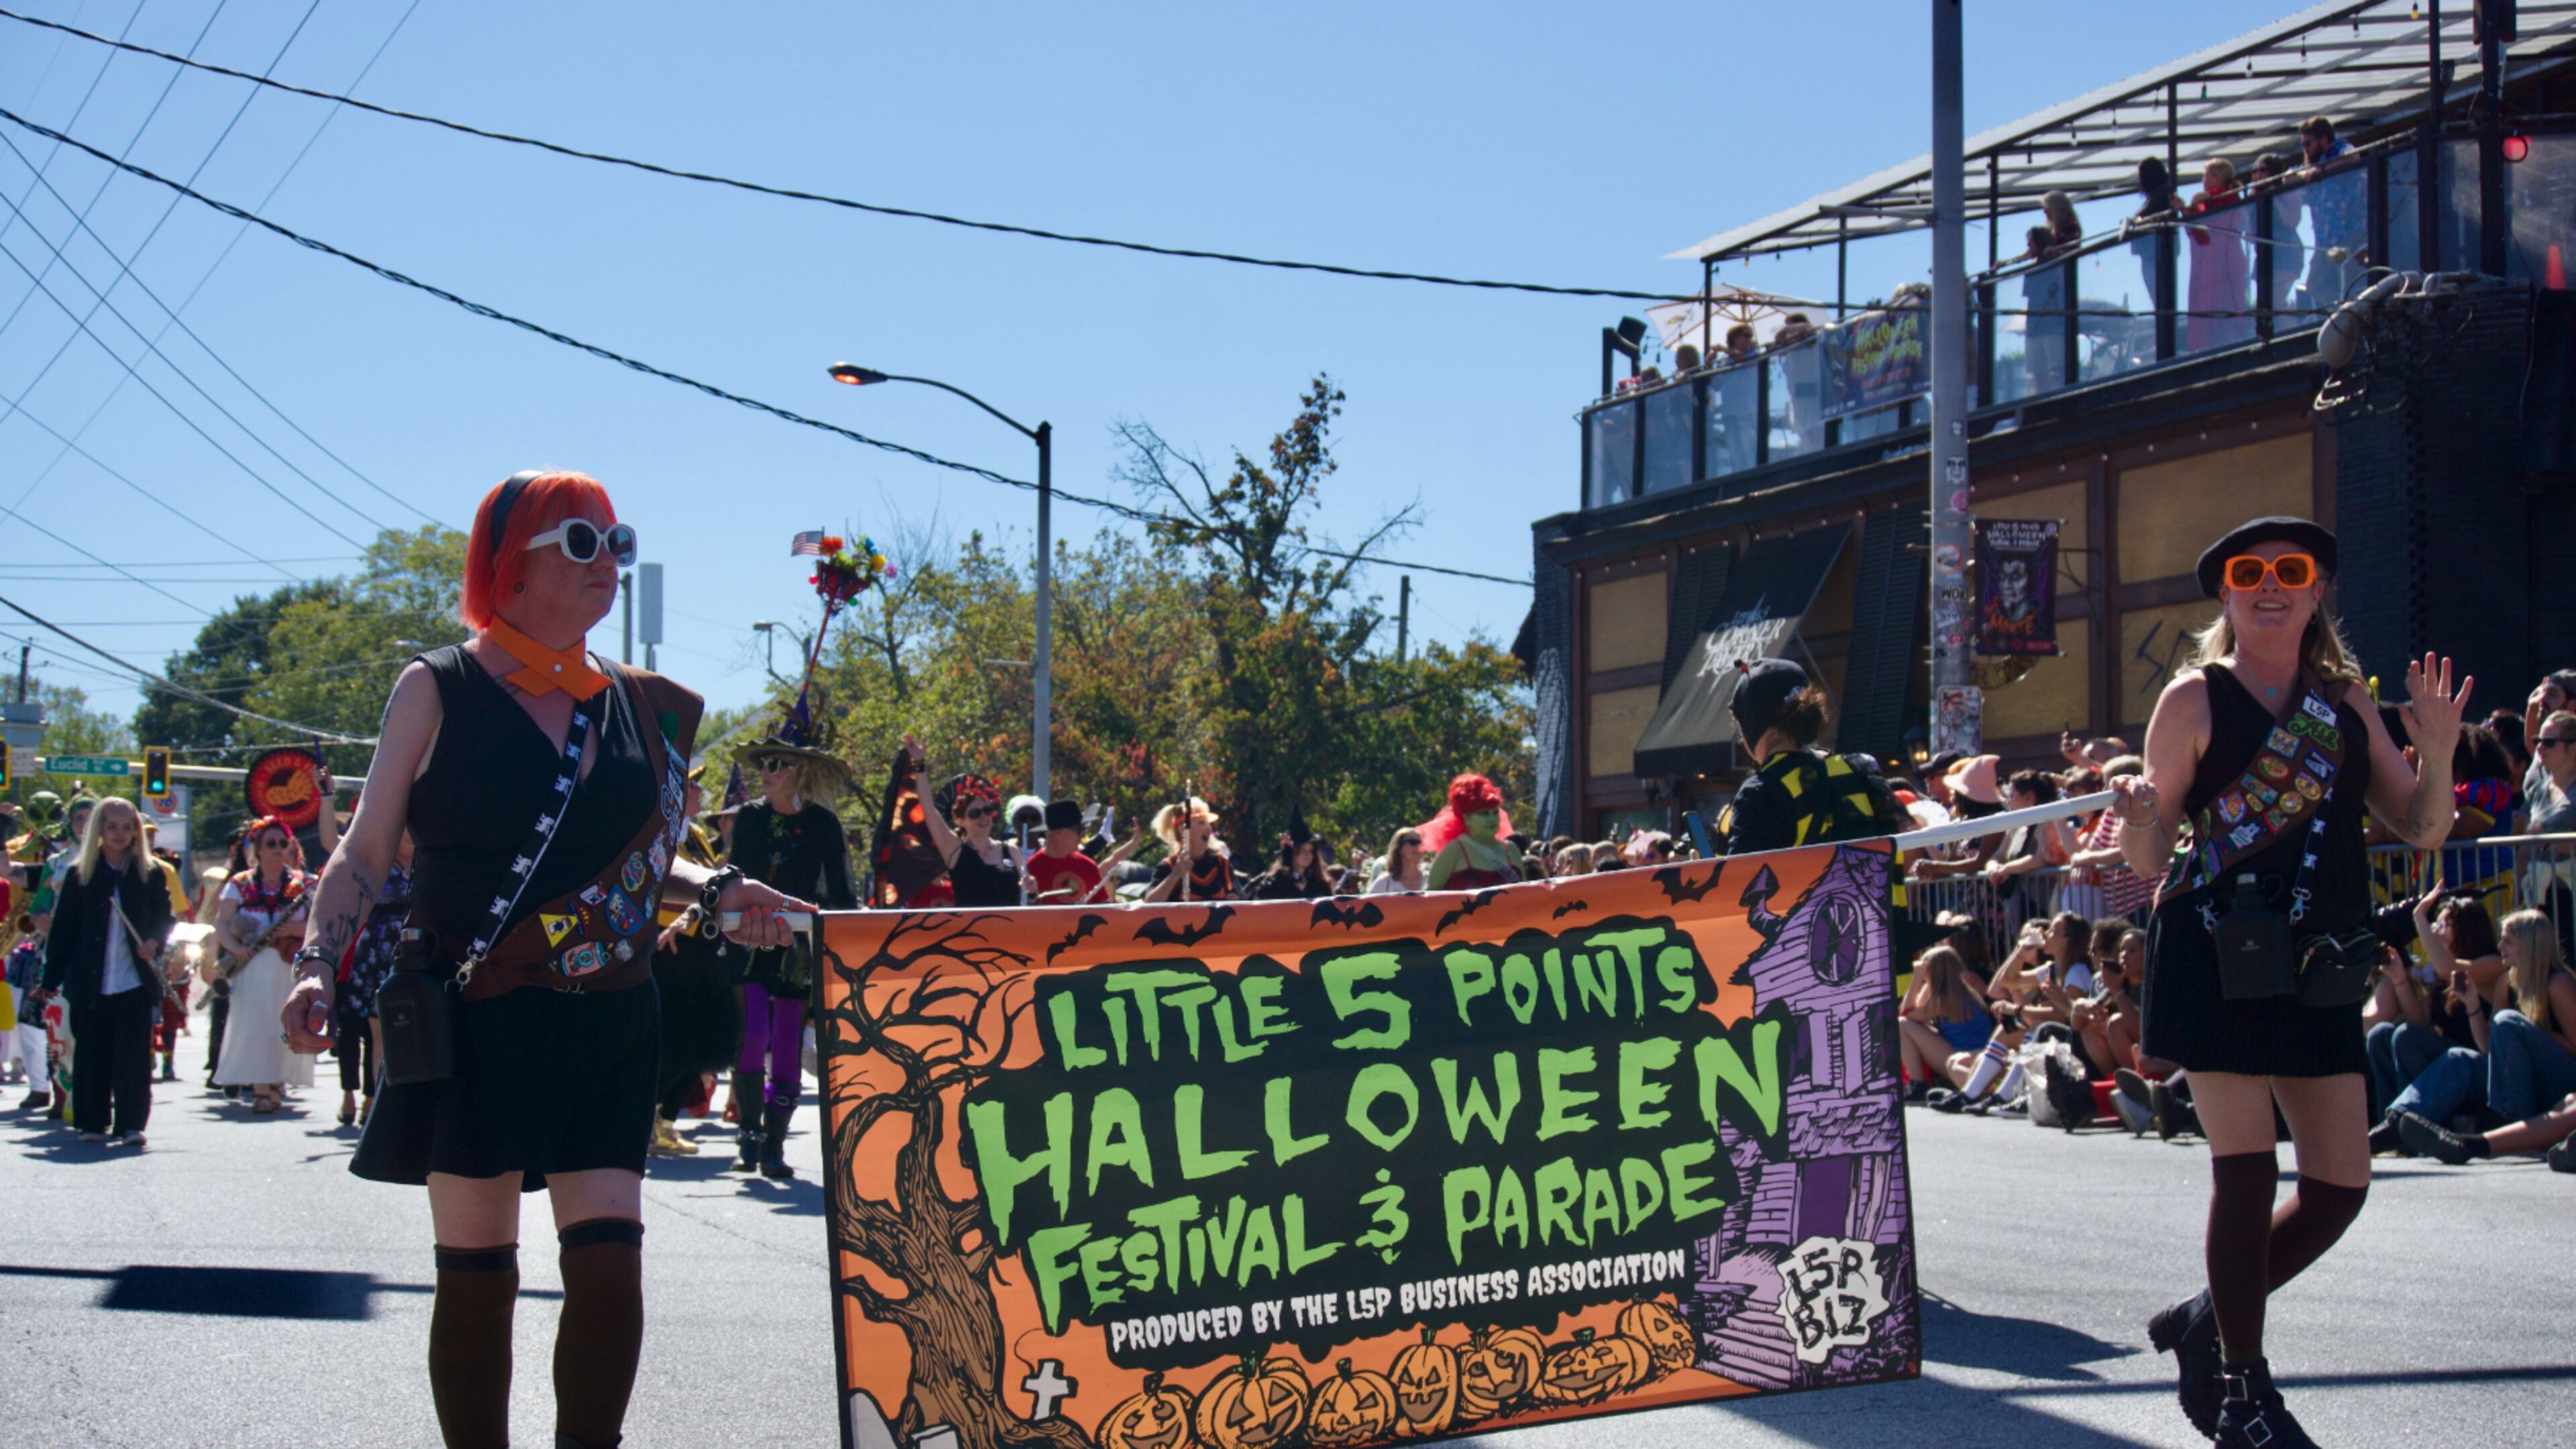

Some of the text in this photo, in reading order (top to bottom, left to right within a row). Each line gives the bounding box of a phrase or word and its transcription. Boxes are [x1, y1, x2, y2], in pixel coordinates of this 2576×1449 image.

[2308, 702, 2330, 718] L5P
[50, 757, 88, 771] Euclid
[1049, 927, 1696, 1071] LITTLE 5 POINTS
[967, 1020, 1782, 1246] HALLOWEEN
[1027, 1138, 1725, 1334] FESTIVAL & PARADE
[1786, 1246, 1863, 1305] L5P
[1111, 1248, 1685, 1353] PRODUCED BY THE L5P BUSINESS ASSOCIATION
[1793, 1293, 1867, 1349] BIZ
